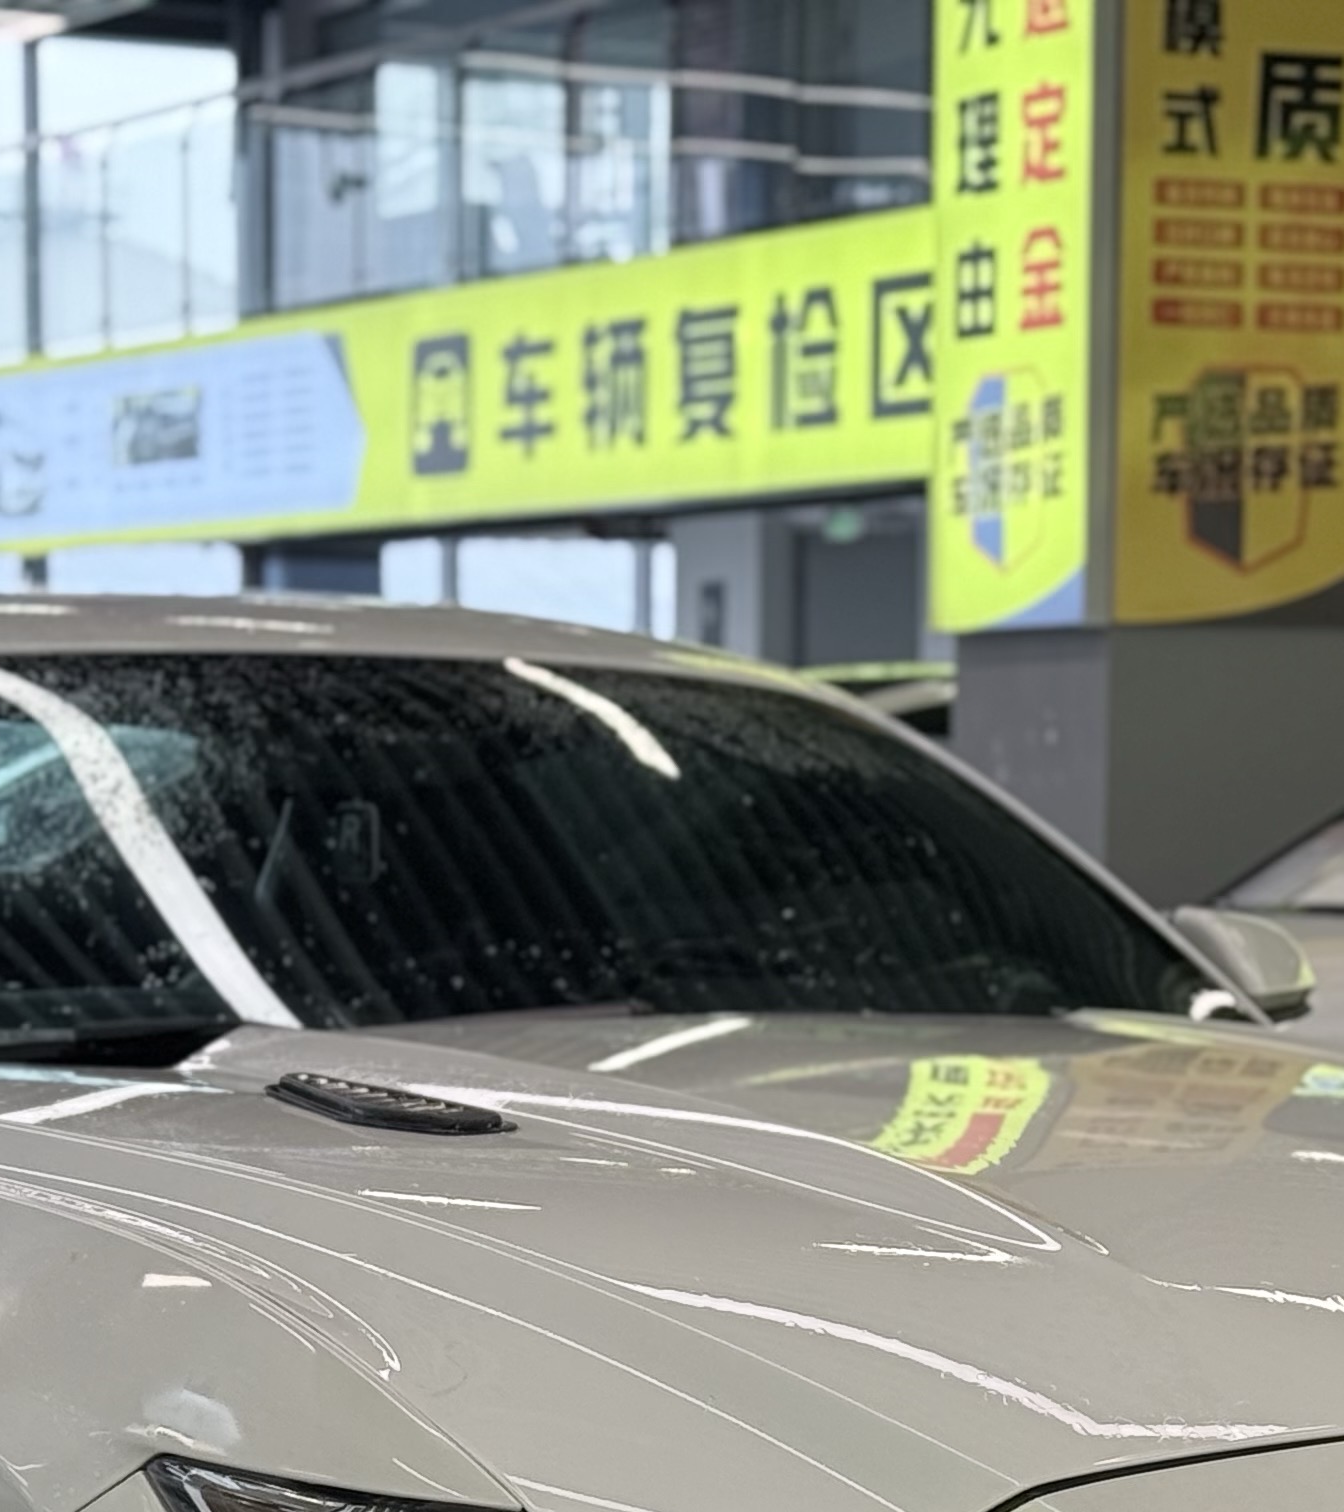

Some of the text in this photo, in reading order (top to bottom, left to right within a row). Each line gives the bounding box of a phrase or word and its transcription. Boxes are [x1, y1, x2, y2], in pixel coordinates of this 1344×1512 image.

[498, 271, 933, 456] 车辆复检区
